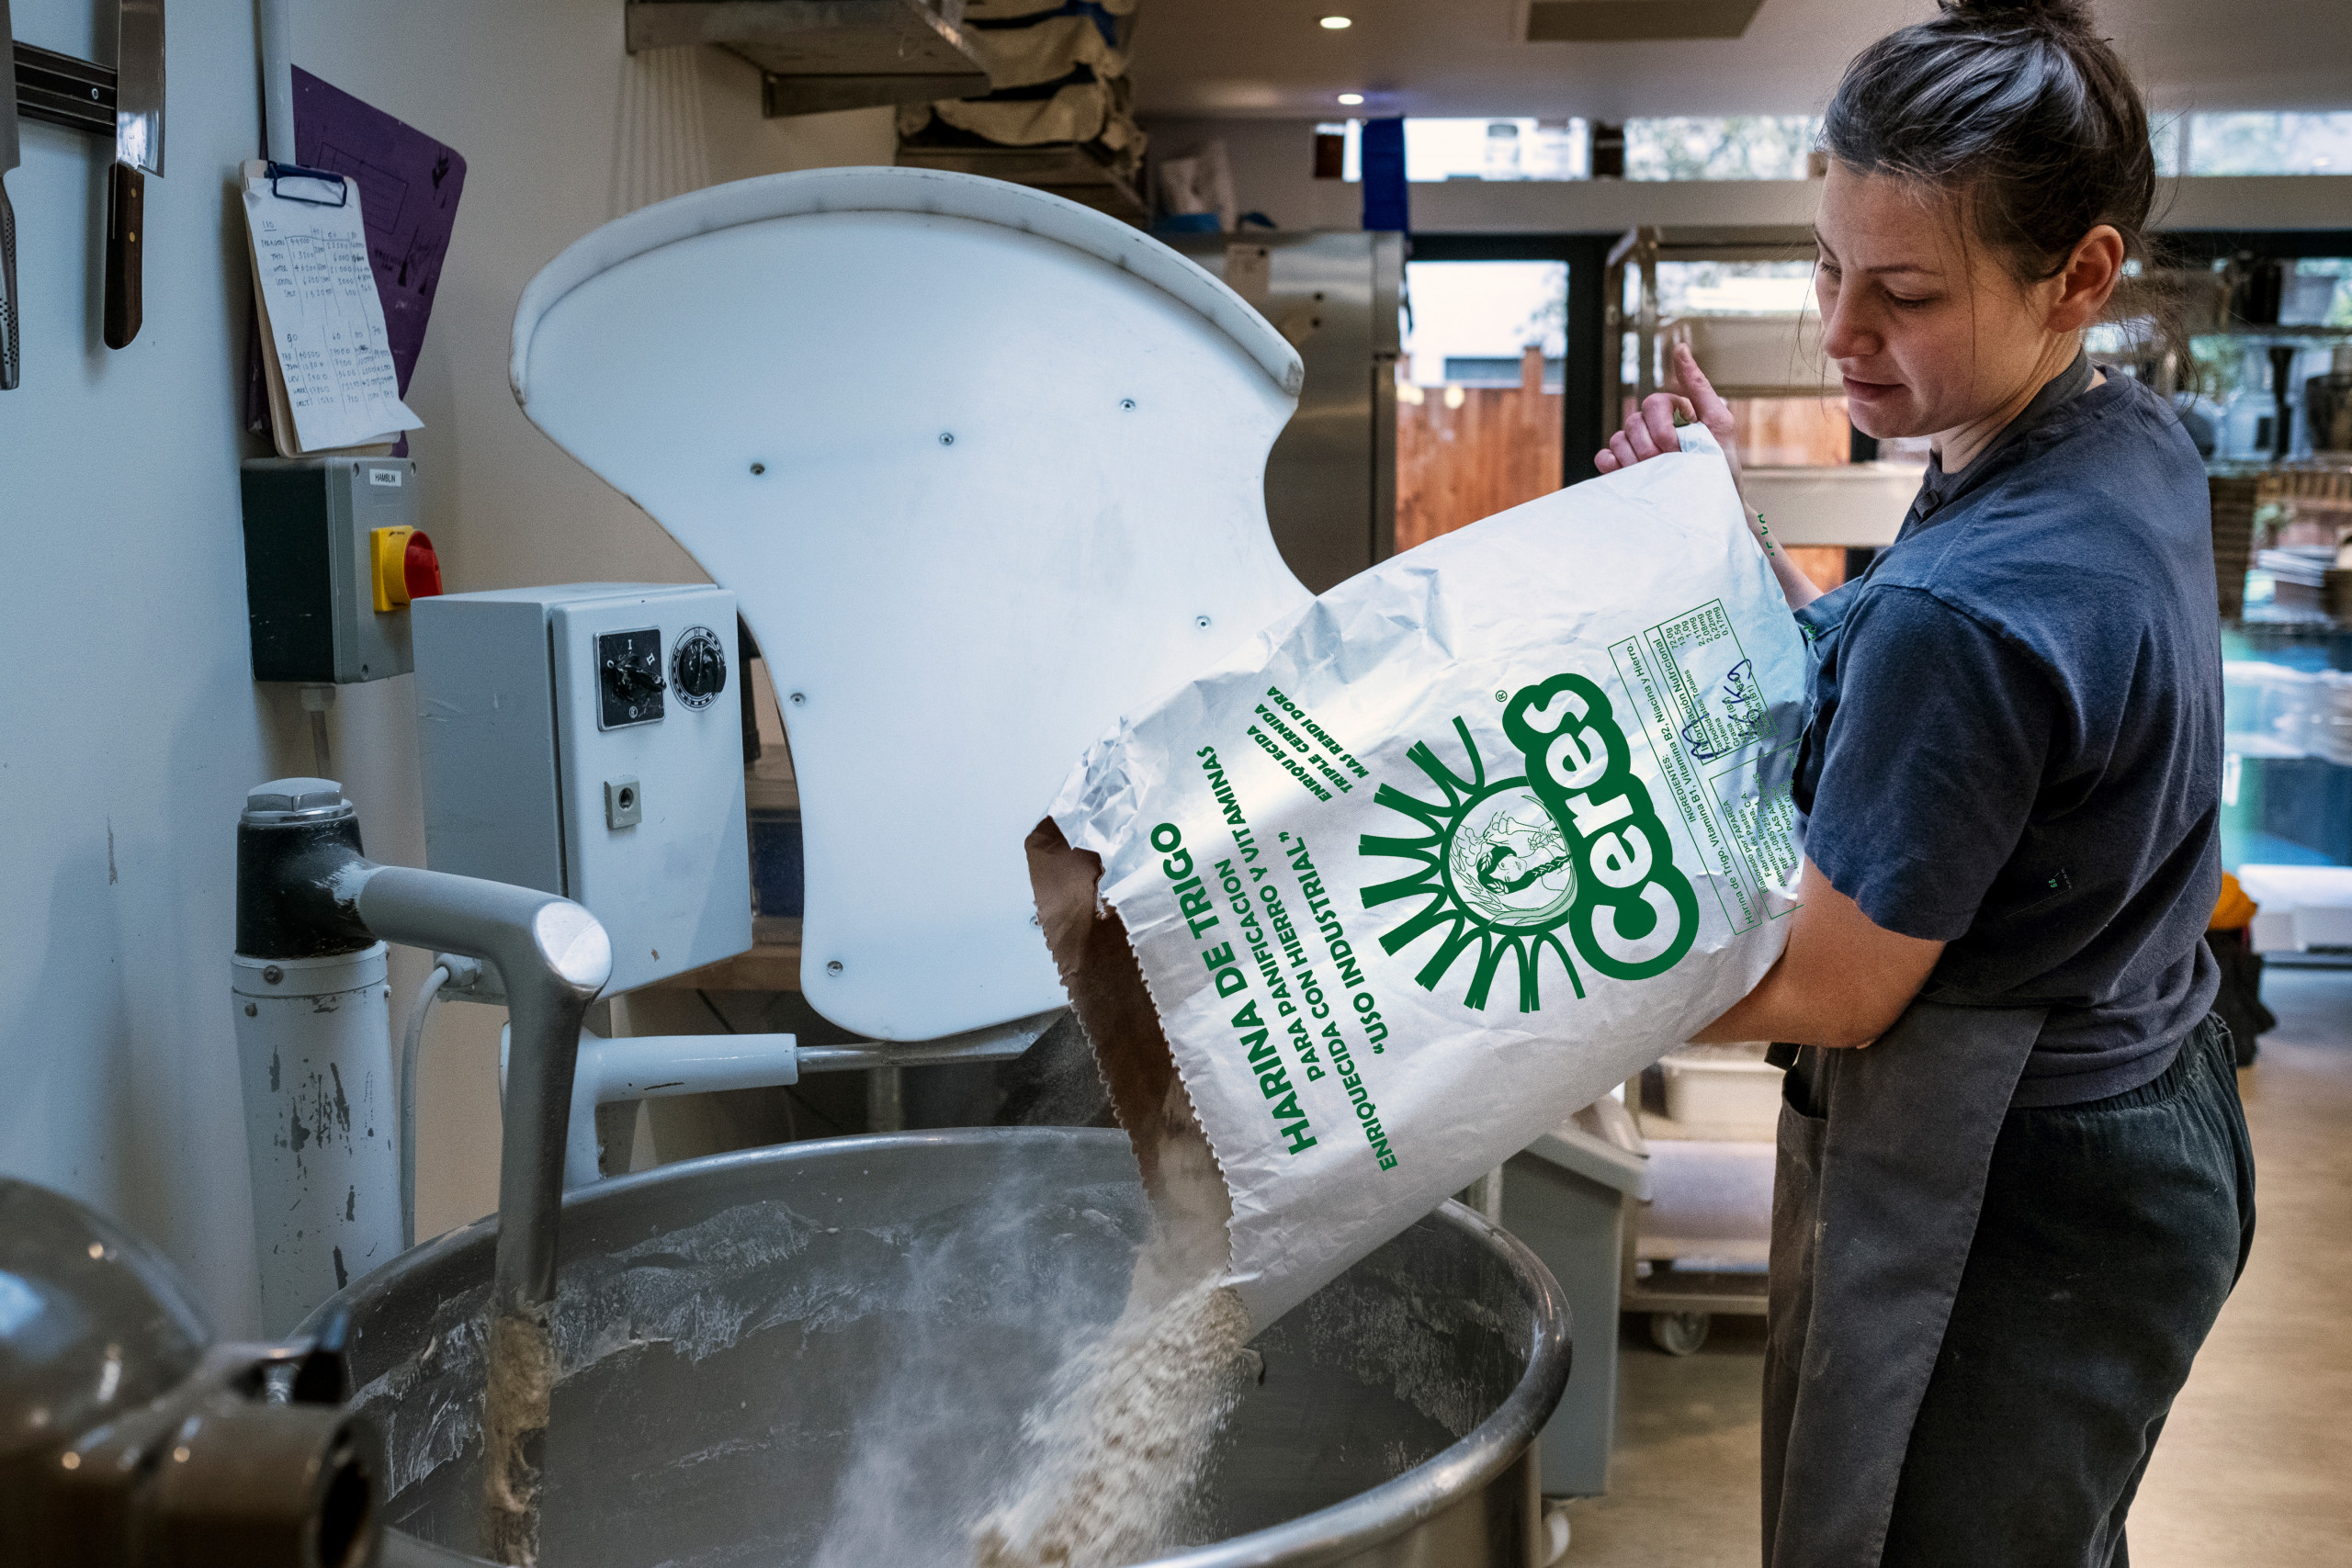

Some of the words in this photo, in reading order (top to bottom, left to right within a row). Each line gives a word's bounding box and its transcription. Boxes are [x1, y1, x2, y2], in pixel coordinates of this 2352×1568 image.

[1665, 626, 1681, 649] 72,0g
[1672, 623, 1686, 647] 13,5g
[1680, 620, 1693, 638] 1,0g
[1689, 616, 1709, 647] 2,11mg
[1697, 613, 1713, 644] 2,08mg
[1704, 609, 1722, 640] 0,22mg
[1711, 605, 1729, 637] 0,17mg
[1626, 642, 1645, 677] Hierro.
[1652, 637, 1683, 694] Nutricional
[1639, 677, 1651, 685] y
[1684, 669, 1700, 700] Totales
[1644, 684, 1667, 724] Niacina
[1253, 703, 1310, 754] CERNIDA
[1660, 722, 1674, 742] B2,
[1678, 692, 1710, 752] Información
[1713, 716, 1734, 750] Proteína
[1726, 722, 1741, 748] Grasa
[1307, 753, 1354, 795] TRIPLE
[1338, 753, 1371, 780] MAS
[1668, 740, 1692, 786] Vitamina
[1662, 756, 1699, 824] INGREDIENTES:
[1688, 784, 1702, 804] B1,
[1697, 803, 1720, 848] Vitamina
[1723, 800, 1745, 840] FAPARCA
[1738, 807, 1754, 836] Pastas
[1770, 786, 1793, 831] Portuguesa
[1770, 815, 1784, 833] LAS
[1520, 687, 1683, 966] Ceres
[1749, 836, 1758, 847] de
[1717, 846, 1734, 877] Trigo,
[1740, 839, 1753, 854] por
[1754, 847, 1772, 878] Fabrica
[1762, 840, 1787, 887] Alimenticias
[1778, 852, 1791, 870] RIF:
[1150, 823, 1219, 940] TRIGO
[1250, 867, 1268, 882] Y
[1728, 876, 1740, 890] de
[1747, 853, 1770, 895] Elaborado
[1735, 890, 1755, 926] Harina
[1214, 858, 1297, 1017] PANIFICACION
[1260, 886, 1308, 968] HIERRO
[1202, 941, 1248, 998] DE
[1295, 970, 1329, 1019] CON
[1287, 1017, 1326, 1082] PARA
[1230, 999, 1317, 1156] HARINA
[1321, 1021, 1398, 1171] ENRIQUECIDA
